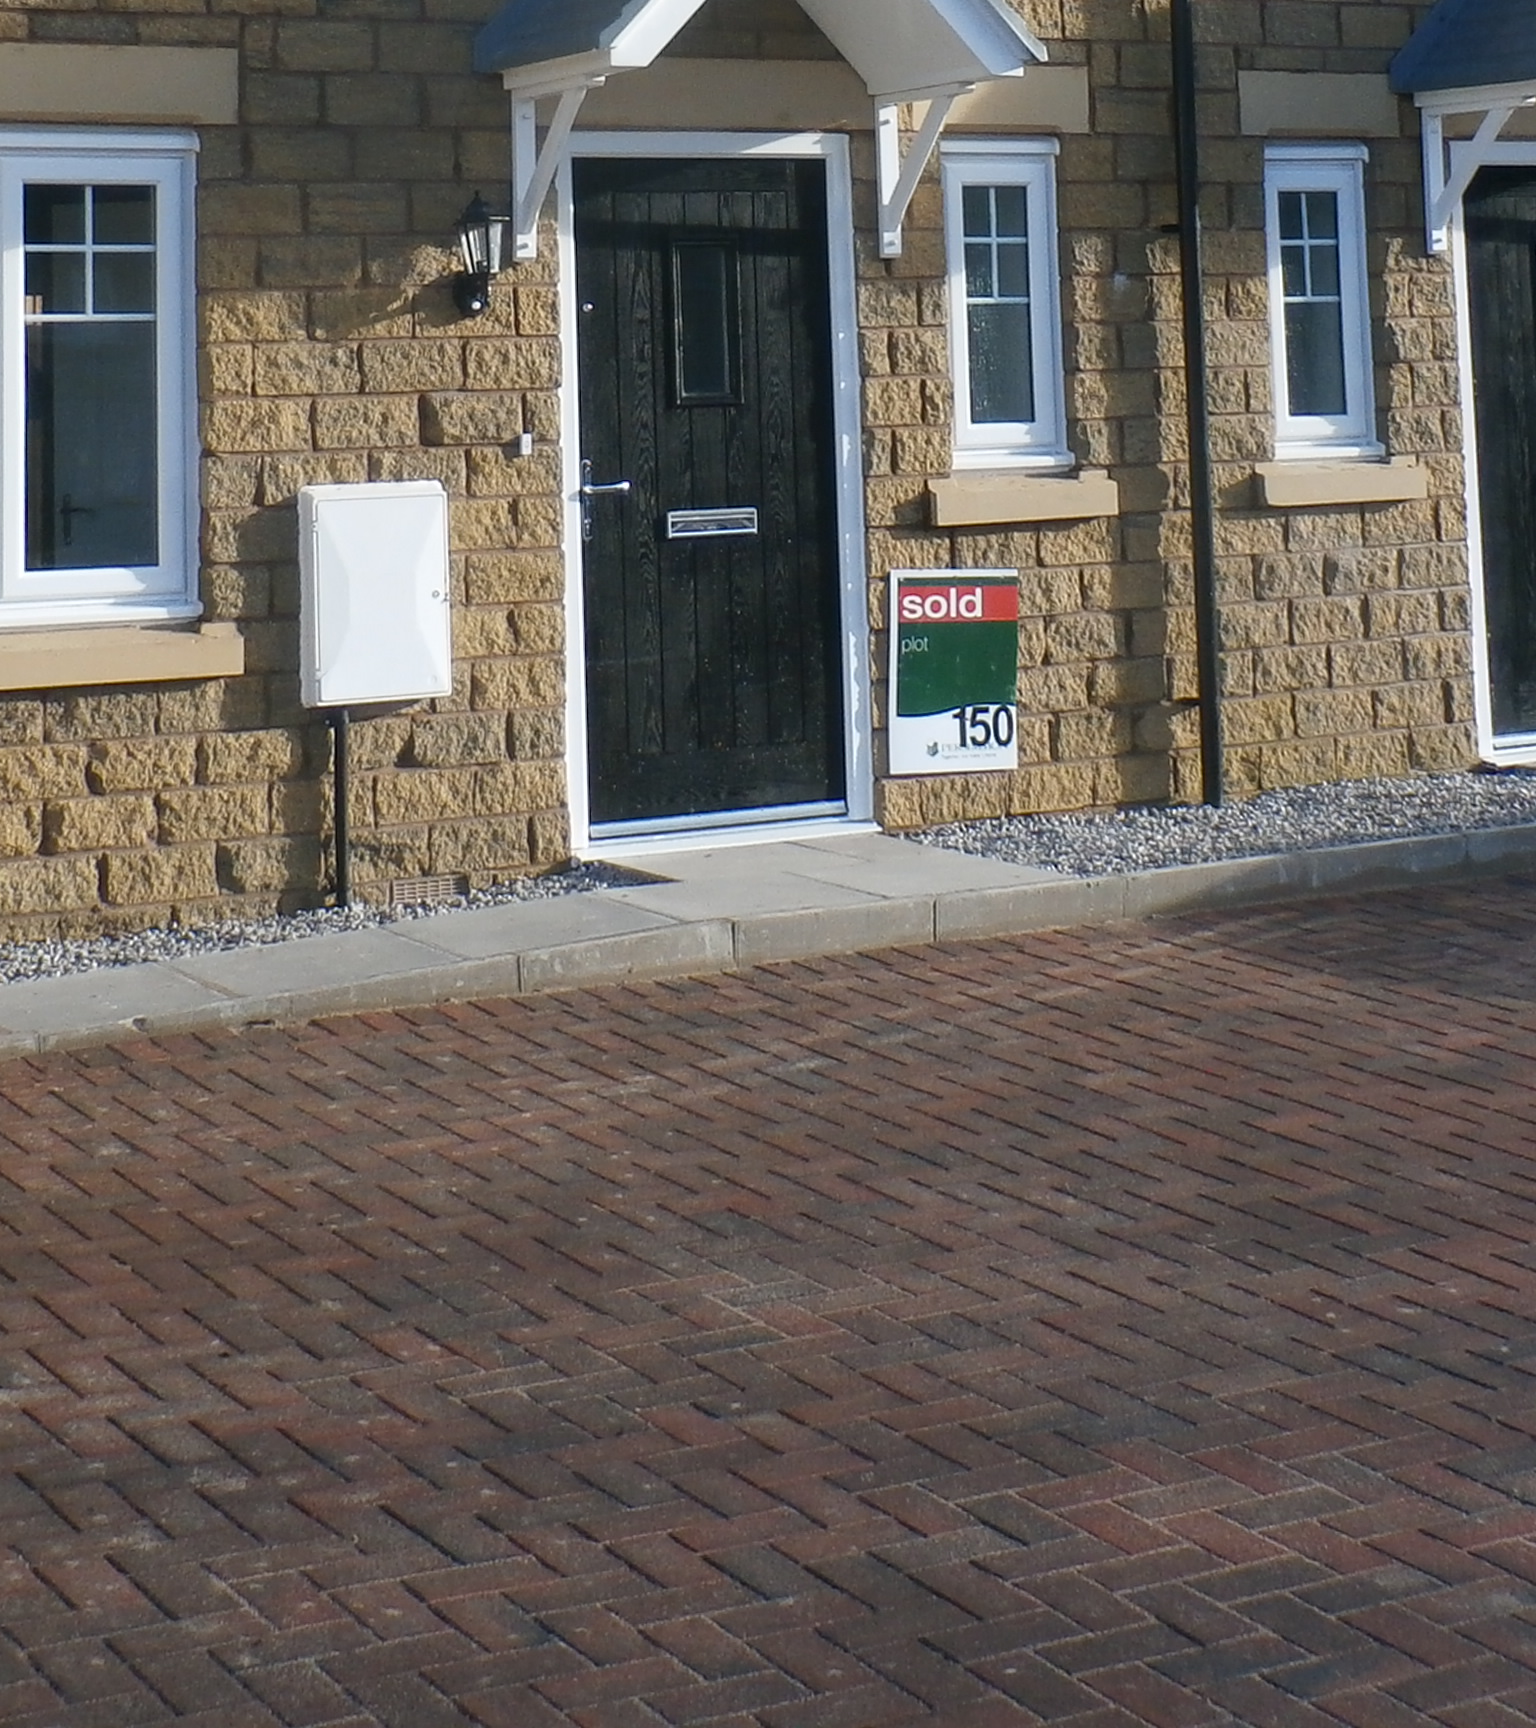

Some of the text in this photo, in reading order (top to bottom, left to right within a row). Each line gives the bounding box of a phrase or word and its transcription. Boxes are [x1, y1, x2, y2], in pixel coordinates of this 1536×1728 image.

[902, 587, 982, 619] sold
[901, 636, 929, 654] plot
[952, 705, 1014, 747] 150
